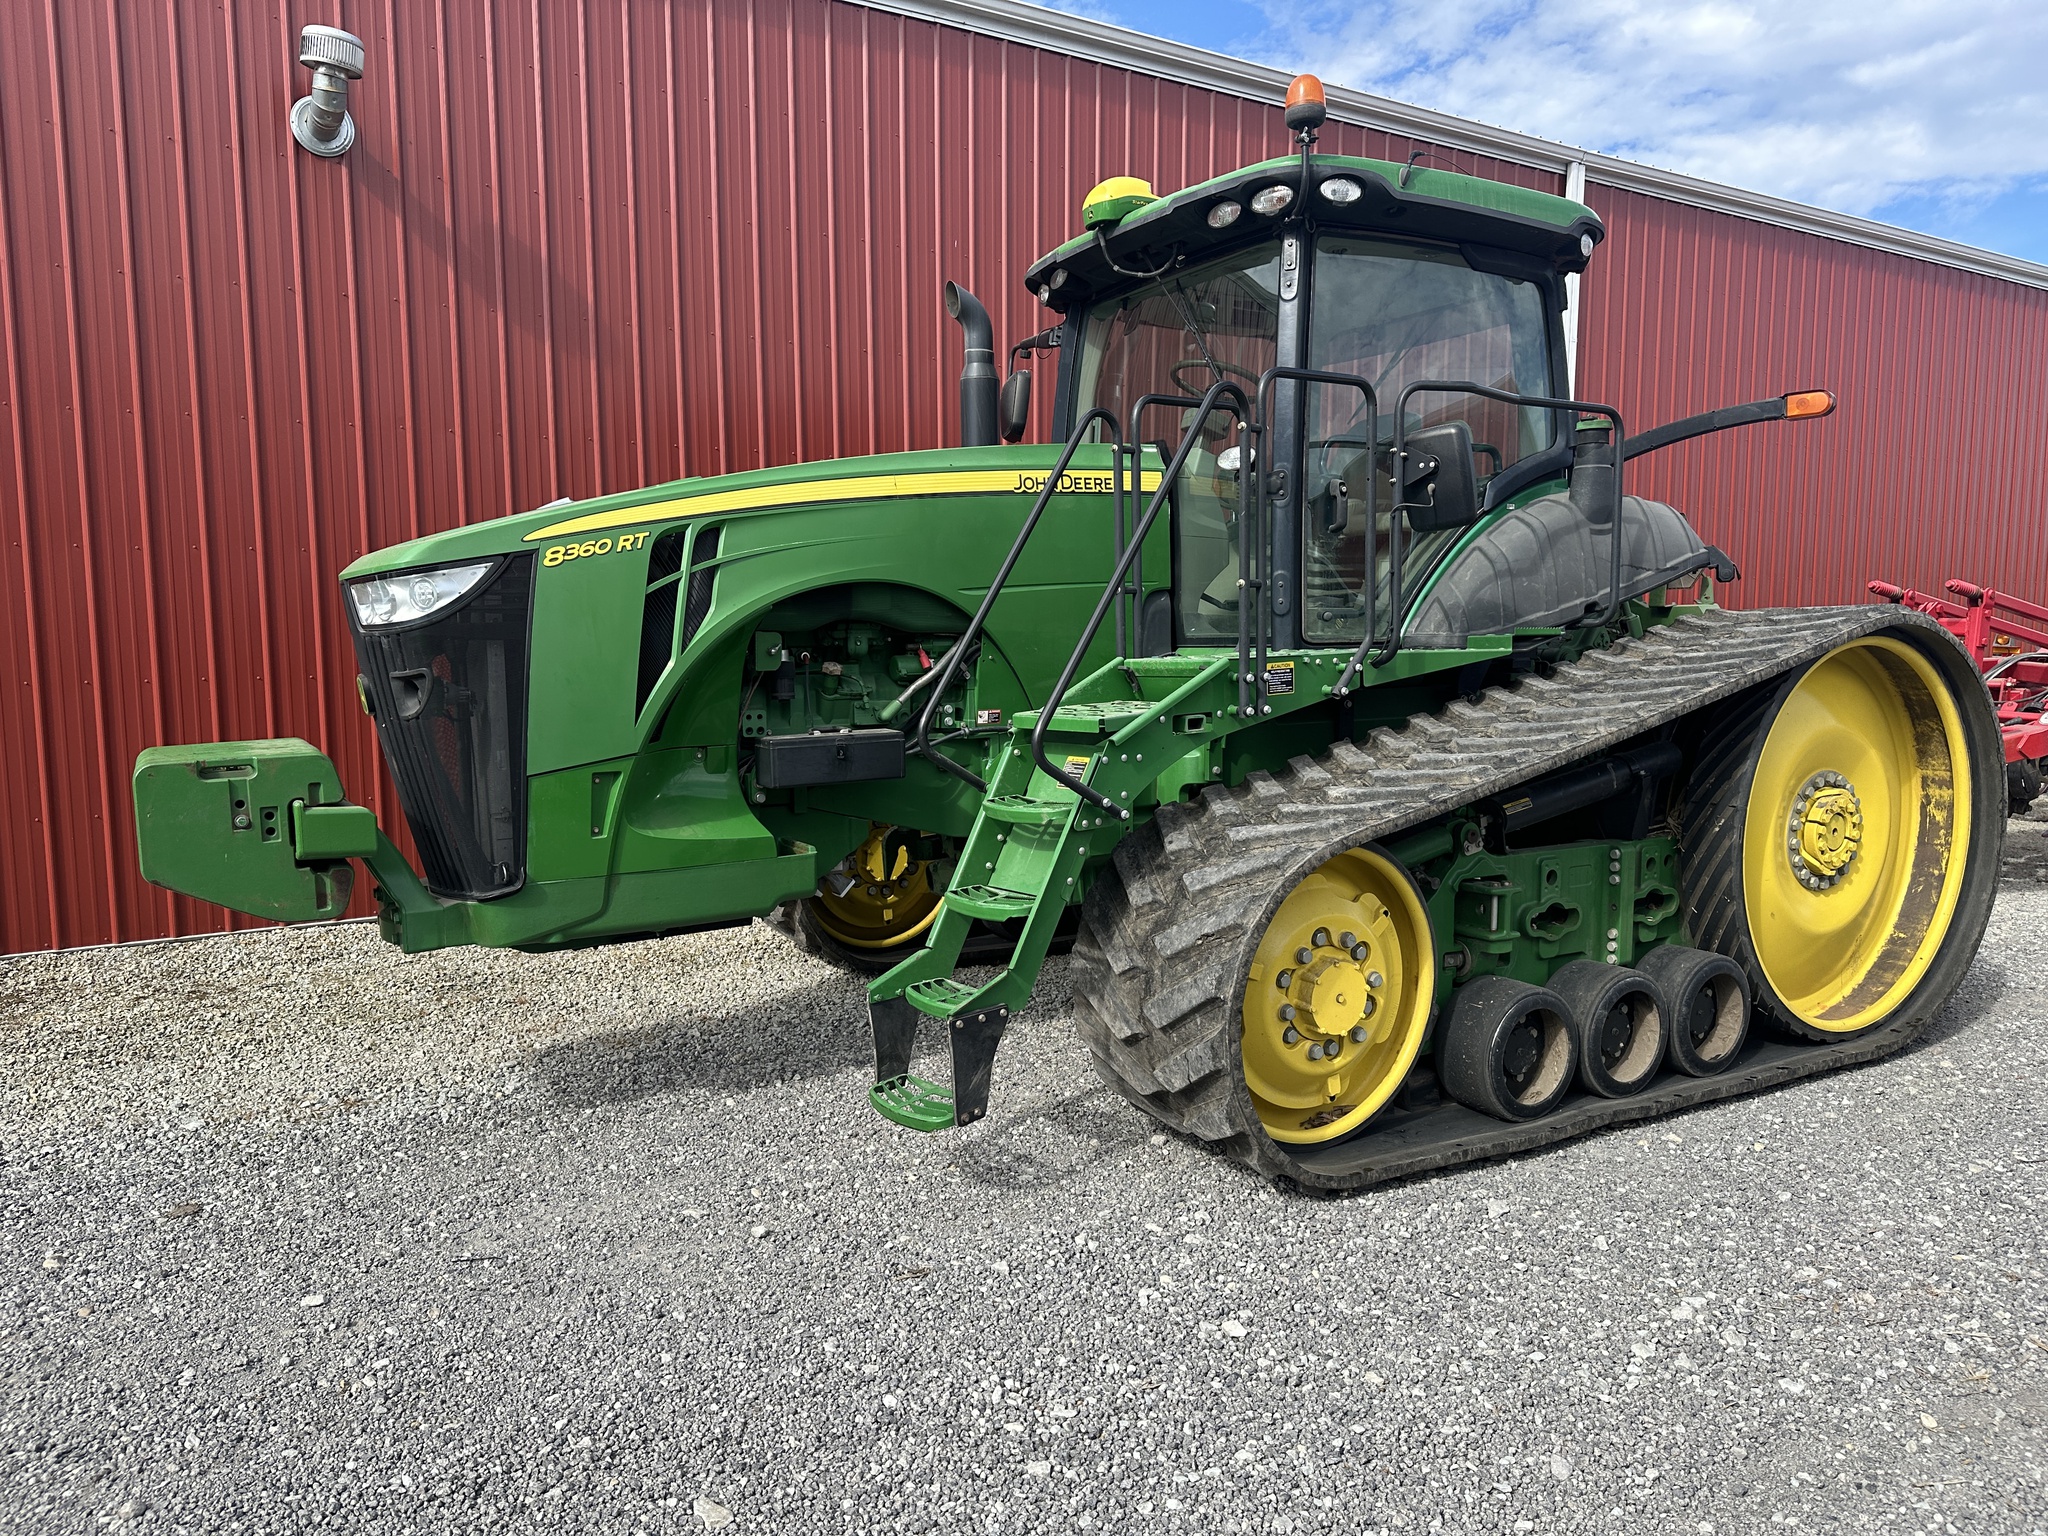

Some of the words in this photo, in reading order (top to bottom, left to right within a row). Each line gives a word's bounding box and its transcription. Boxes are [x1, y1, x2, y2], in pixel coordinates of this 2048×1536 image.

[1013, 473, 1058, 491] JOH
[1060, 473, 1113, 491] DEERE
[542, 538, 613, 567] 8360
[616, 531, 651, 553] RT
